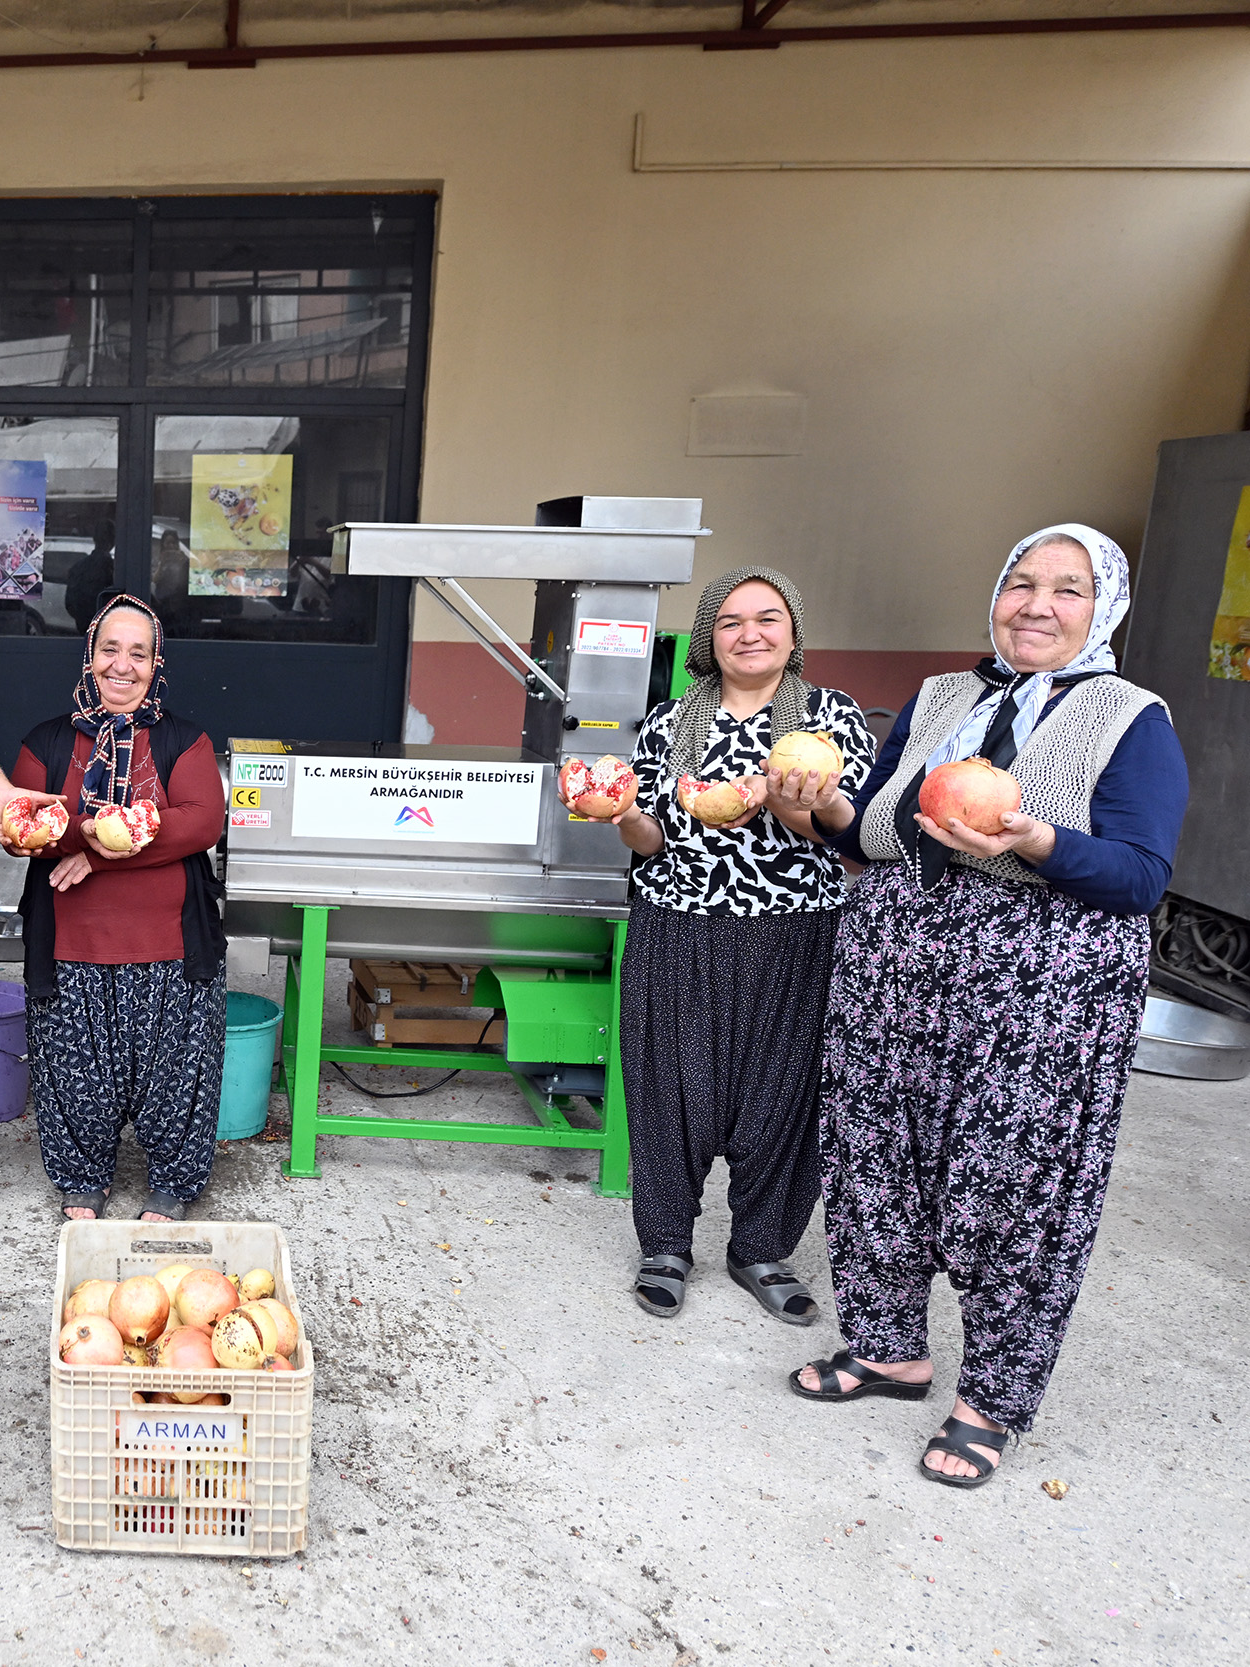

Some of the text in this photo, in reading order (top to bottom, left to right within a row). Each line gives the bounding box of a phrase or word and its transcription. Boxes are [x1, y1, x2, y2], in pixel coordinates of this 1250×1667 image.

[236, 763, 285, 781] NRT2000
[303, 765, 535, 784] T.C. MERSİN BÜYÜKŞEHİR BELEDİYESİ
[235, 790, 257, 805] CE
[369, 785, 464, 800] ARMAĞANIDIR
[136, 1421, 227, 1440] ARMAN
